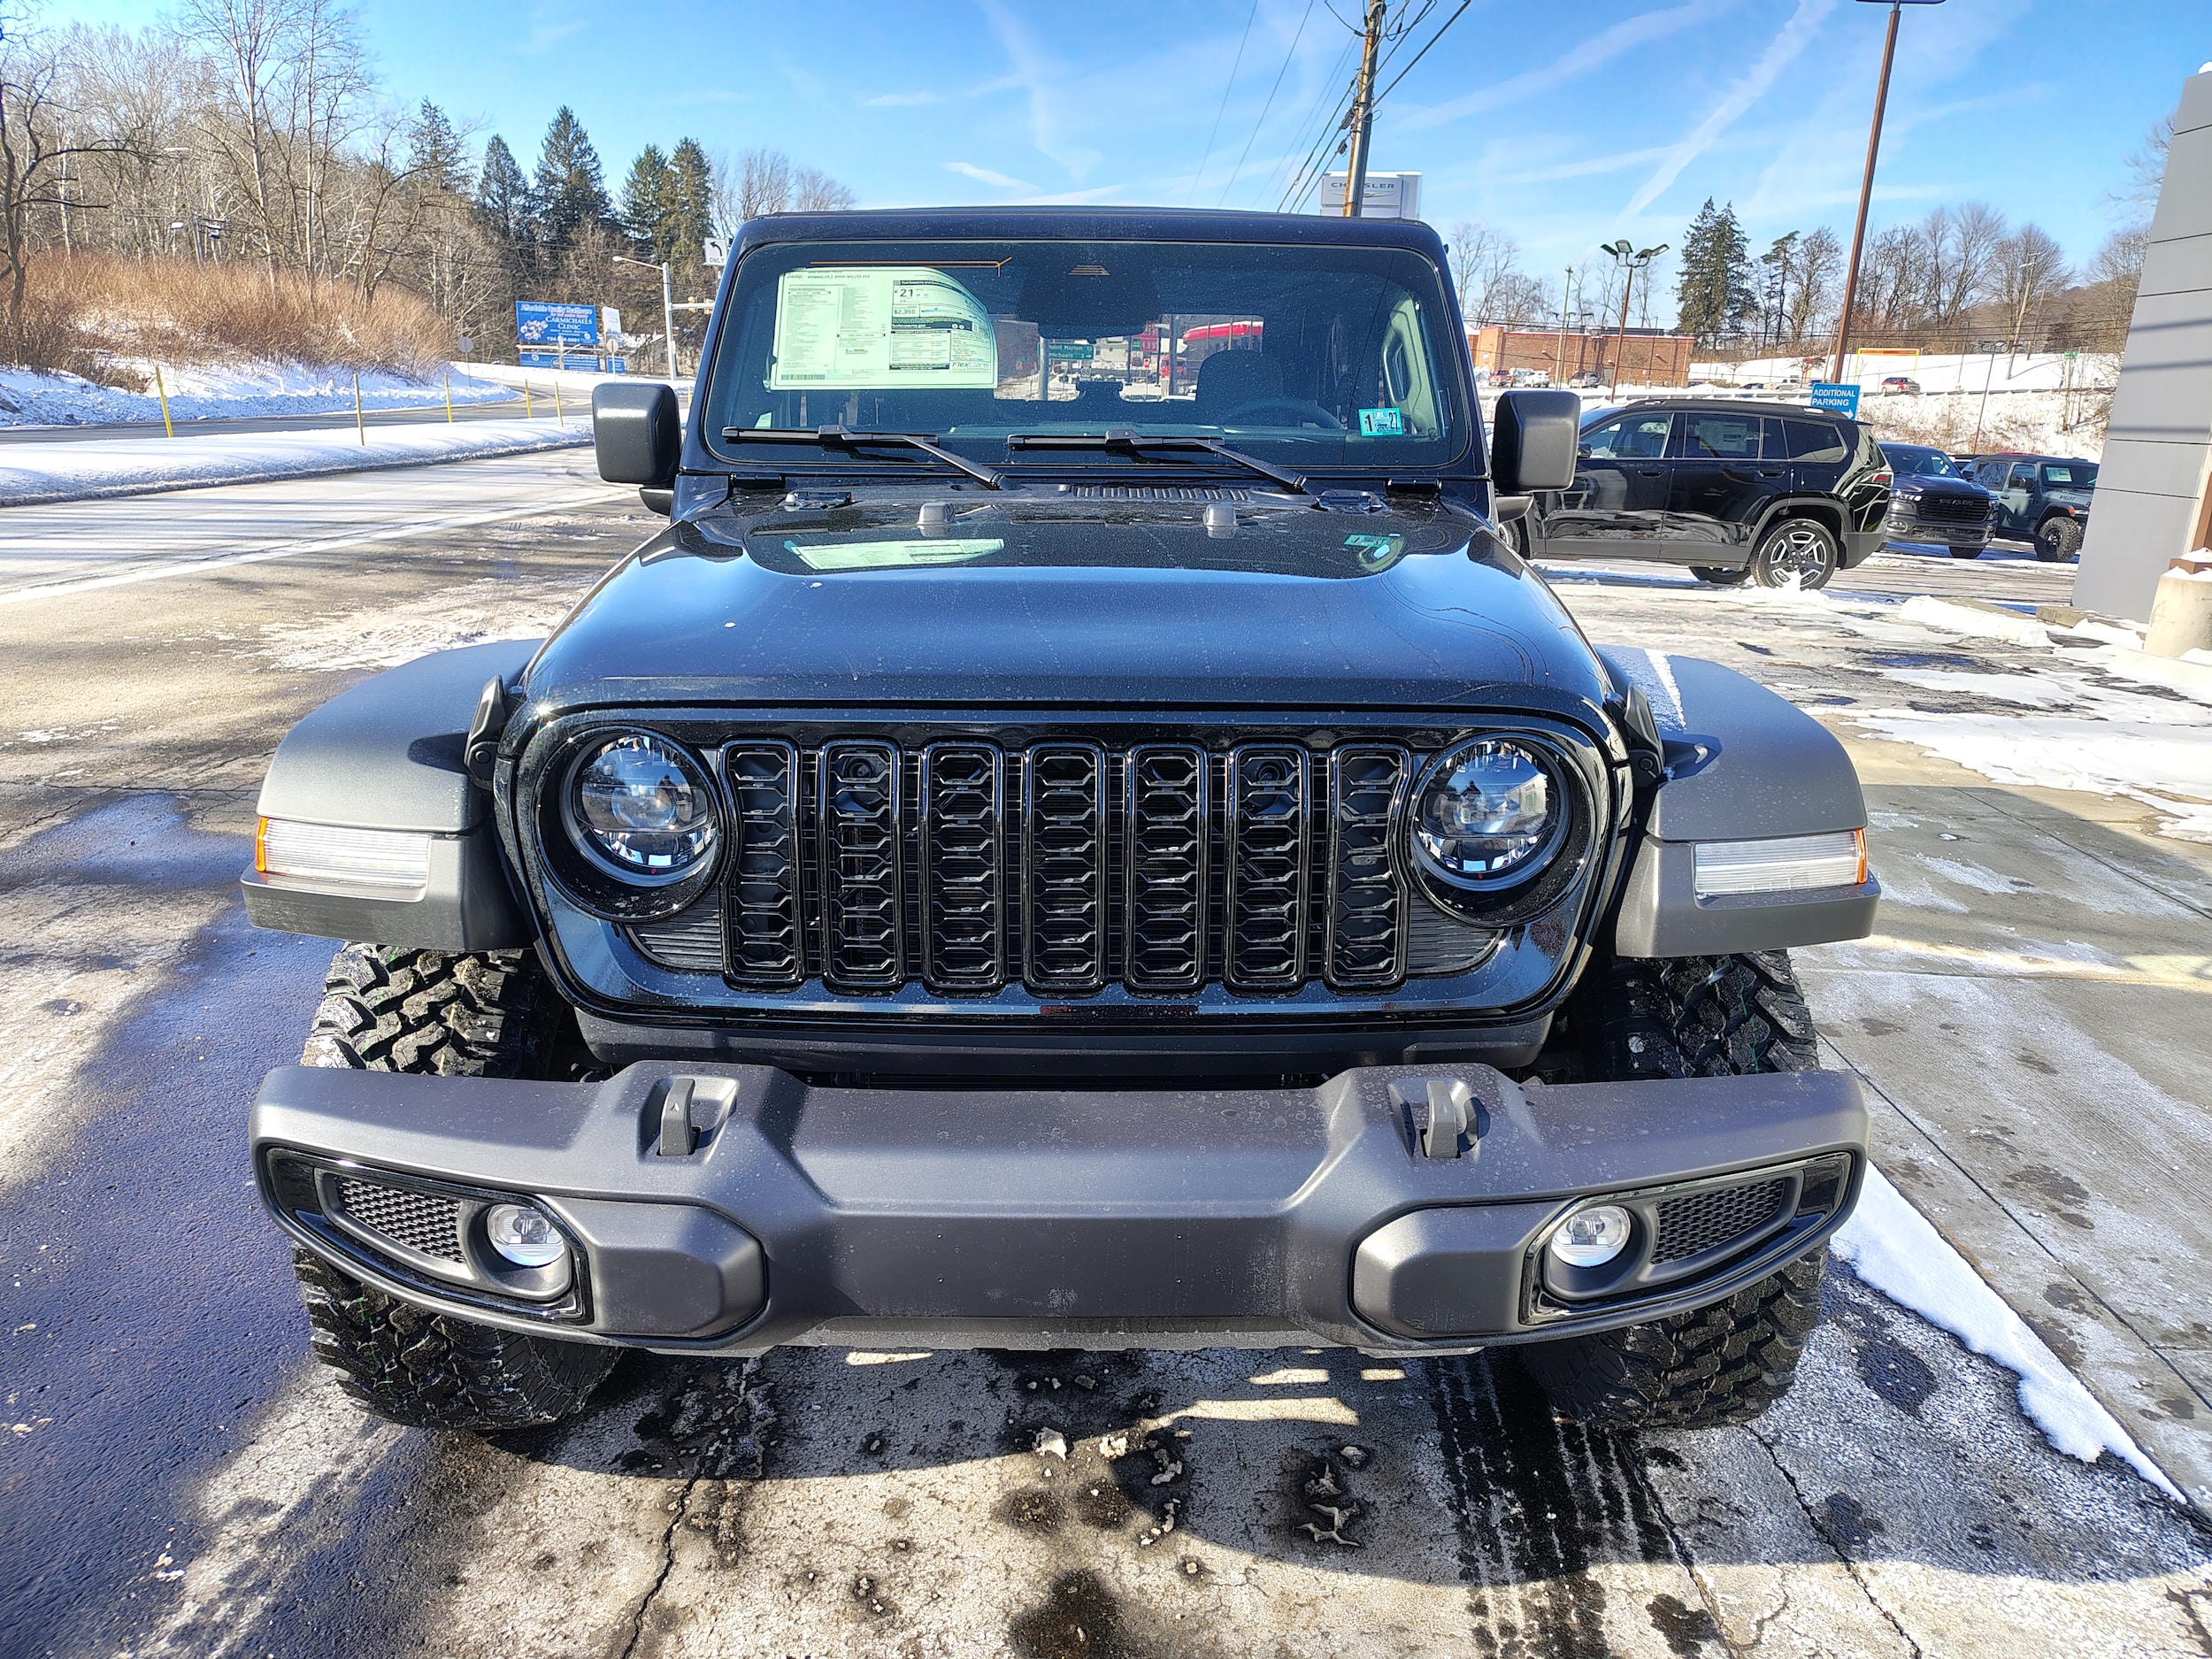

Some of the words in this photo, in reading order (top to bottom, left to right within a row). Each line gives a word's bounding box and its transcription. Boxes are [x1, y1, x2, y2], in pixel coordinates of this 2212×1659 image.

[899, 288, 914, 297] 21
[1811, 398, 1849, 407] PARKING
[1365, 414, 1372, 432] 1
